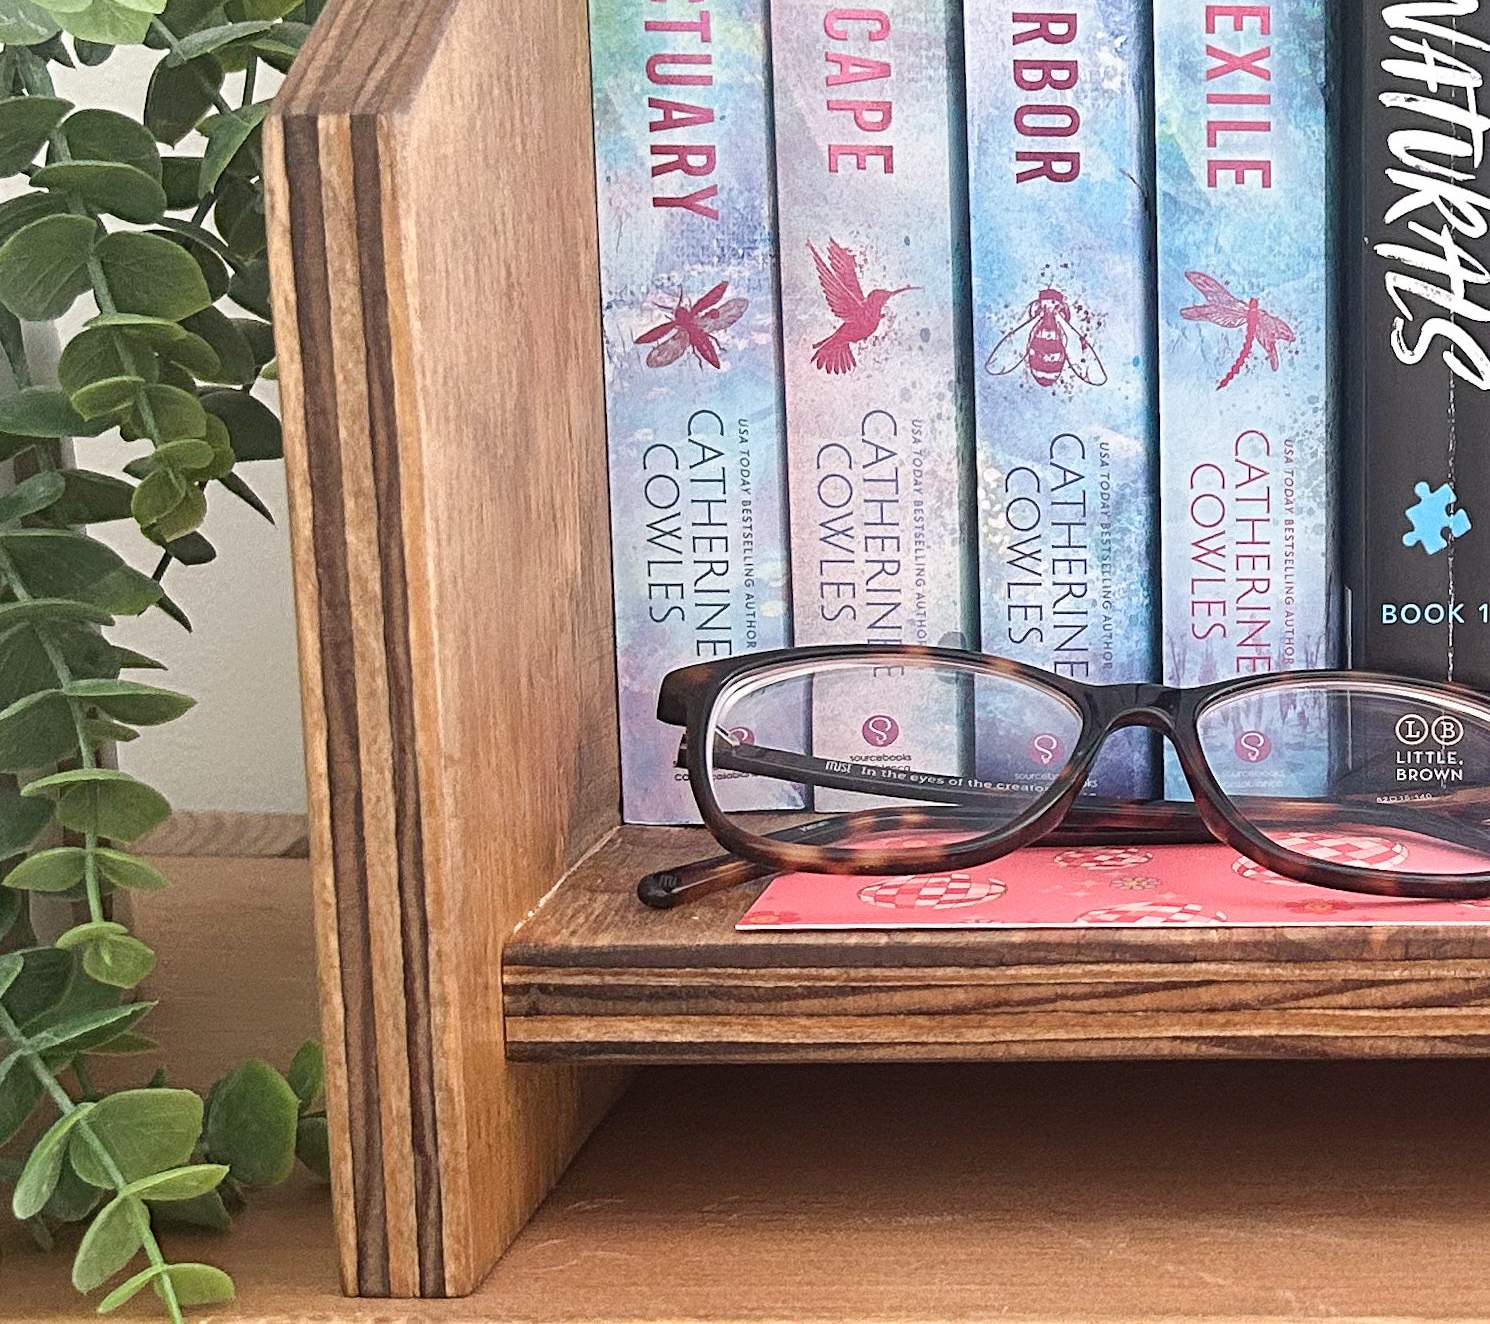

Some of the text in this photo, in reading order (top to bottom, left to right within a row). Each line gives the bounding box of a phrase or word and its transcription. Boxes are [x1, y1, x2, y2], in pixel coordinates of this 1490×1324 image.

[1206, 5, 1272, 189] EXILE
[912, 419, 923, 443] USA
[912, 445, 924, 495] TODAY
[643, 443, 685, 623] COWLES
[688, 409, 731, 657] CATHERINE
[738, 418, 757, 649] USA TODAY BESTSELLING AUTHOR
[816, 443, 856, 622] COWLES
[915, 500, 926, 589] BESTSELLING
[1005, 467, 1043, 644] COWLES
[1049, 433, 1089, 677] CATHERINE
[1099, 442, 1113, 670] USA TODAY BESTSELLING AUTHOR
[1190, 463, 1227, 640] COWLES
[1235, 429, 1271, 673] CATHERINE
[1284, 439, 1294, 666] USA TODAY BESTSELLING AUTHOR
[1382, 603, 1490, 625] BOOK 1
[1396, 751, 1464, 766] LITTLE,
[1396, 768, 1463, 782] BROWN
